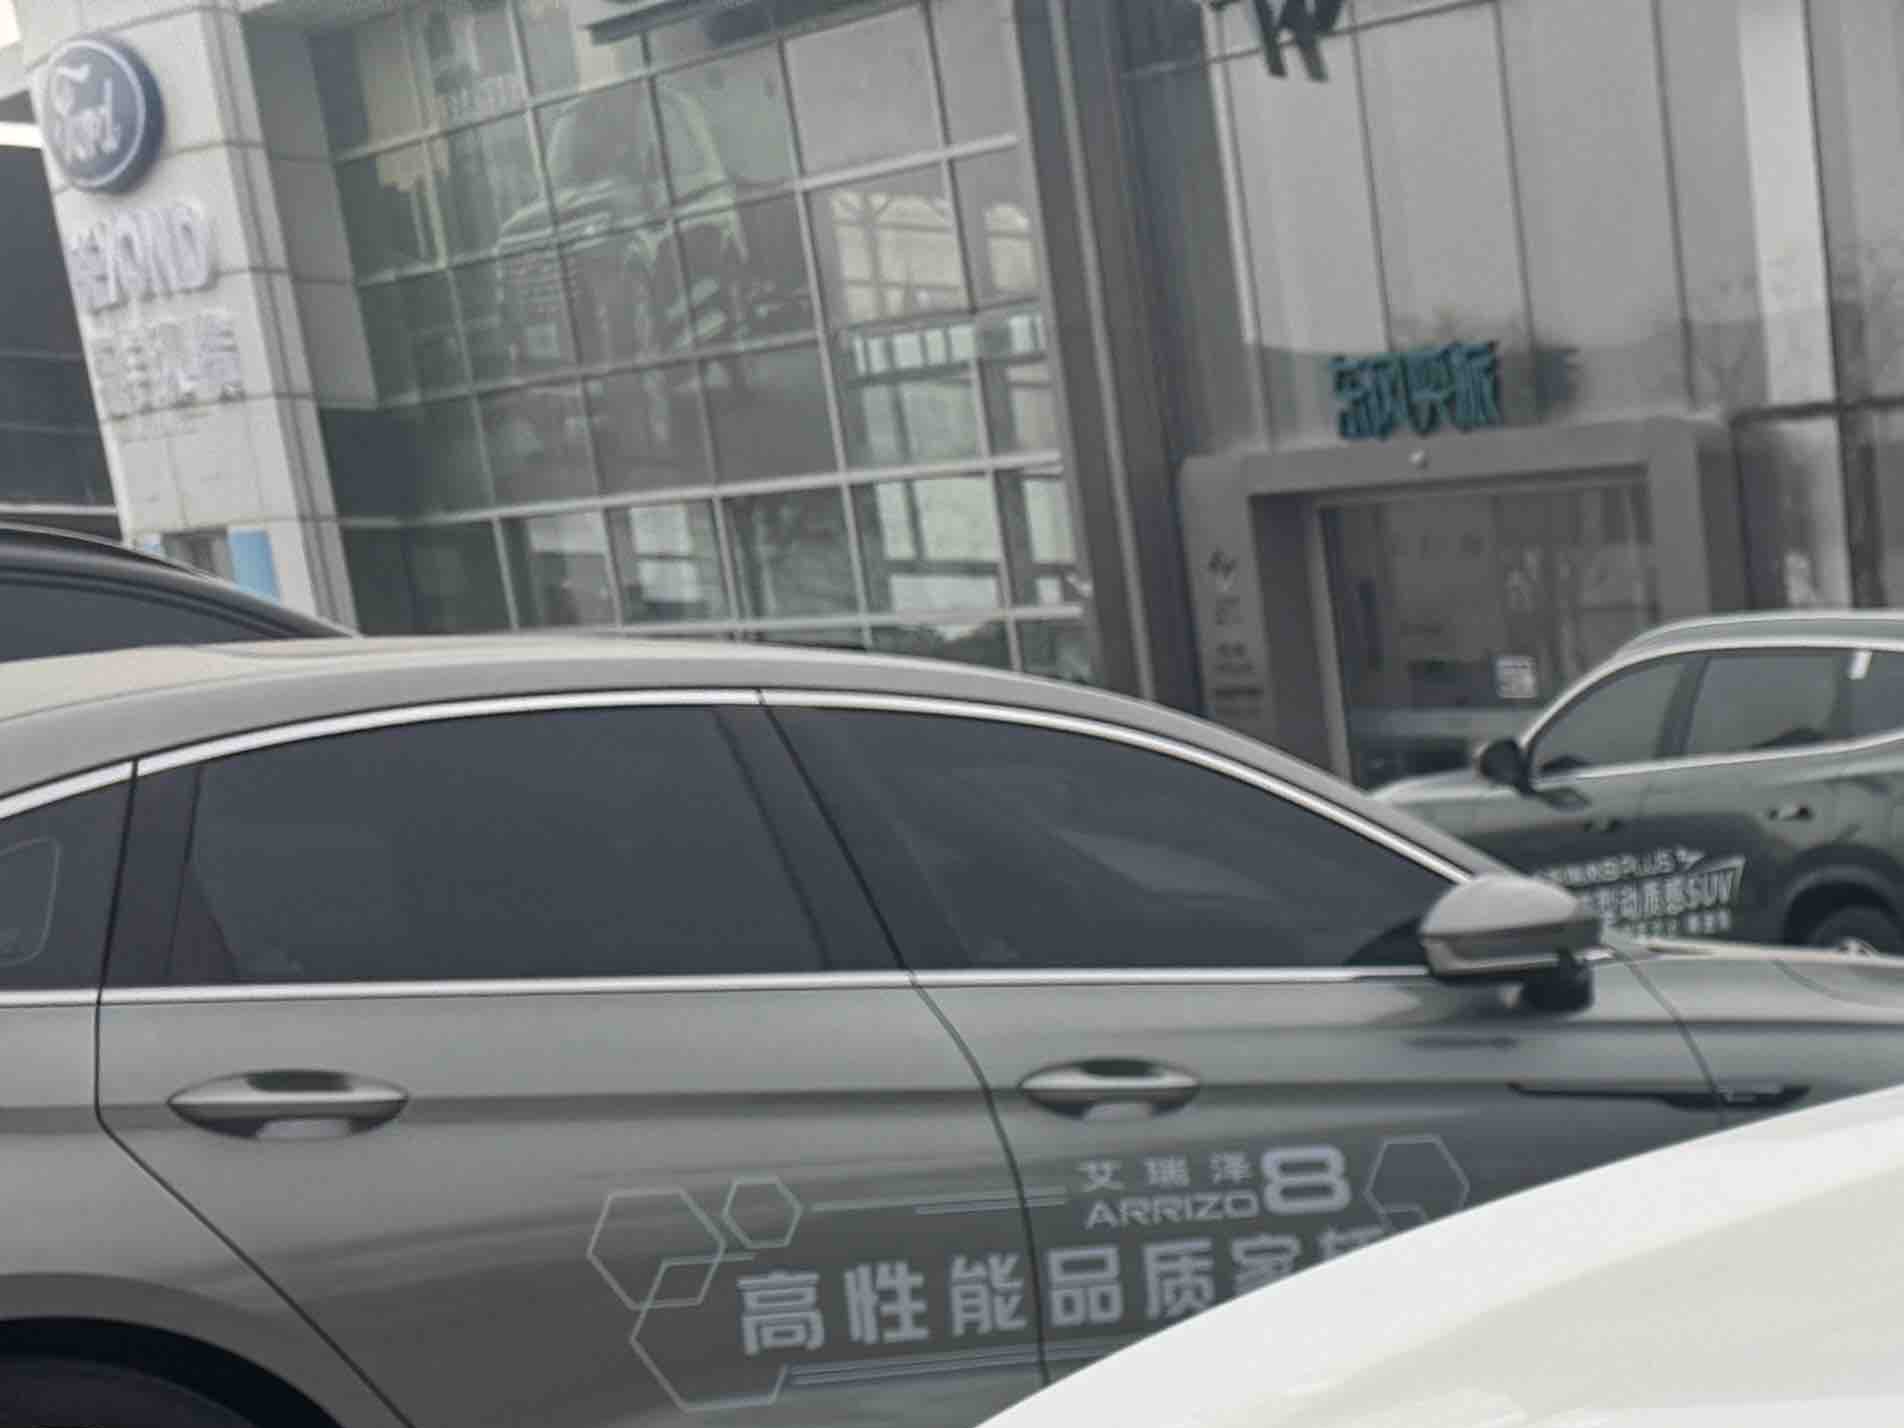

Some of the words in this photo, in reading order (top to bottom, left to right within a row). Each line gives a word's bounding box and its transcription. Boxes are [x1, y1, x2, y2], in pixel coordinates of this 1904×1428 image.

[1076, 1150, 1252, 1193] 艾瑞泽
[1260, 1143, 1352, 1216] 8
[1084, 1189, 1261, 1231] ARRIZO
